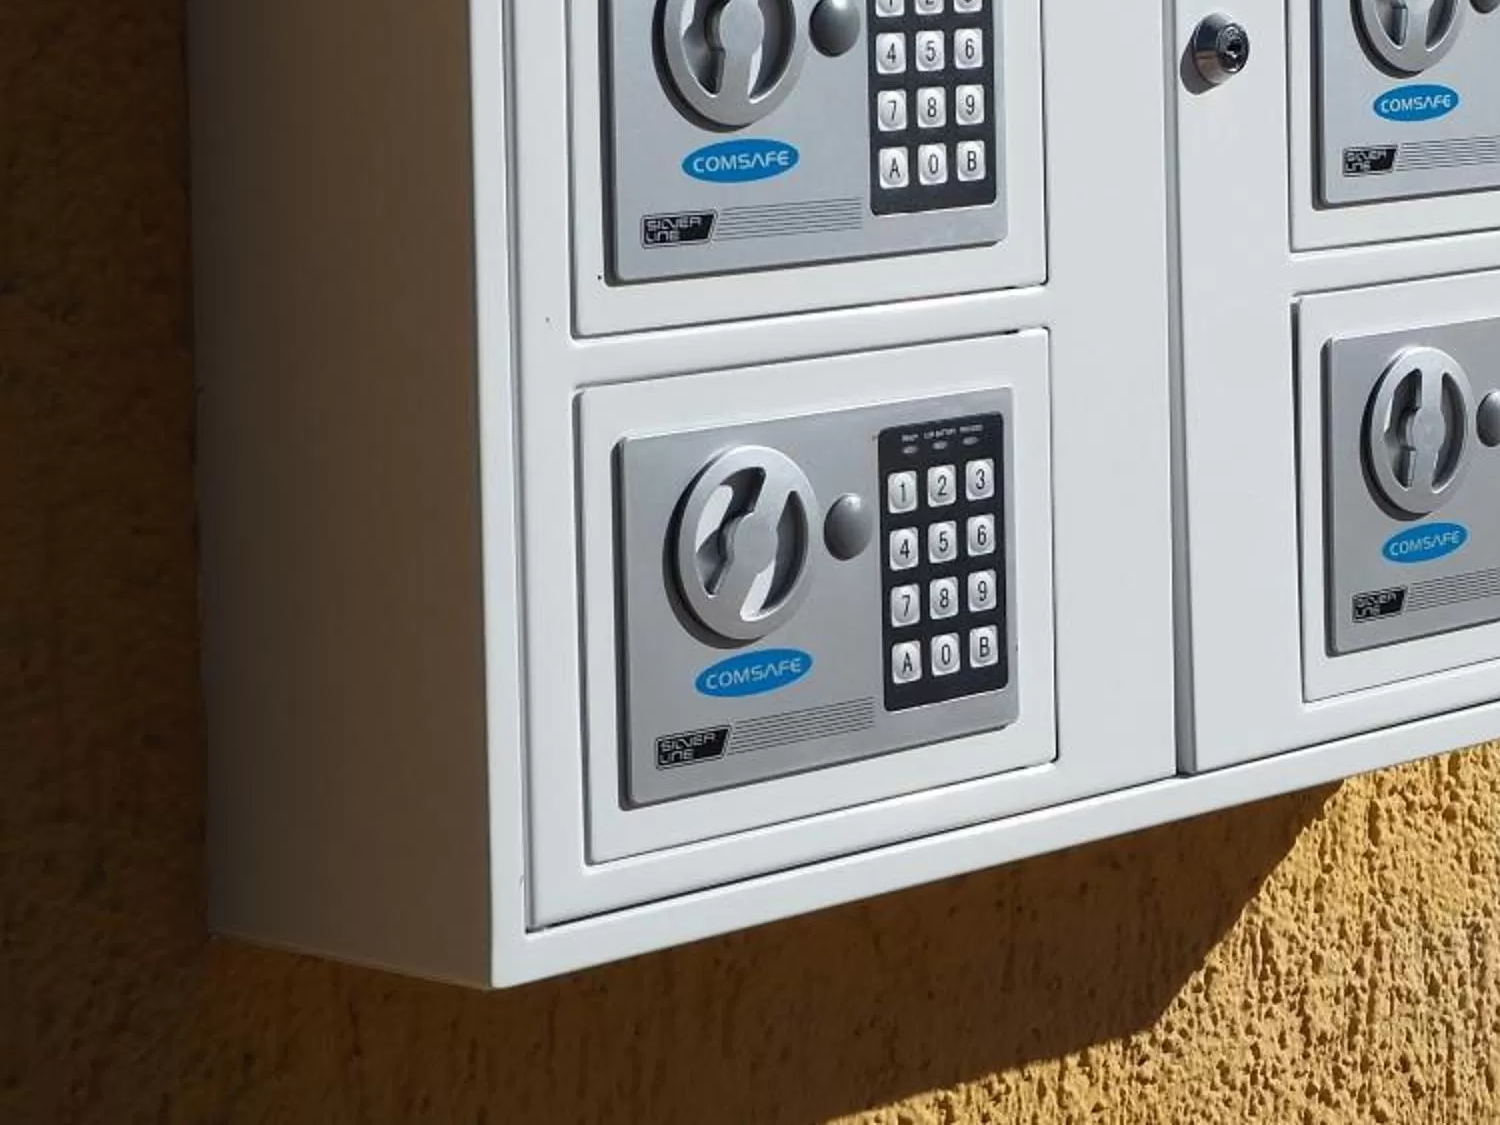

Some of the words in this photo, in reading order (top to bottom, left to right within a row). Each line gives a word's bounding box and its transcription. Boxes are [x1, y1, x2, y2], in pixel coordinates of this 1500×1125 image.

[885, 43, 898, 64] 4
[926, 40, 937, 62] 5
[964, 38, 975, 59] 6
[886, 100, 898, 121] 7
[926, 97, 938, 118] 8
[964, 94, 976, 115] 9
[1380, 94, 1451, 113] COMSAFE
[693, 150, 790, 172] COMSAFE
[888, 158, 902, 179] A
[927, 154, 939, 174] 0
[966, 151, 978, 172] B
[936, 475, 948, 497] 2
[974, 469, 986, 490] 3
[898, 539, 911, 559] 4
[938, 531, 950, 553] 5
[976, 525, 988, 546] 6
[1389, 530, 1460, 556] COMSAFE
[900, 595, 912, 617] 7
[938, 588, 950, 608] 8
[976, 580, 988, 601] 9
[901, 652, 914, 673] A
[940, 644, 952, 665] 0
[978, 637, 990, 657] B
[706, 657, 802, 690] COMSAFE
[660, 732, 717, 752] SILVER
